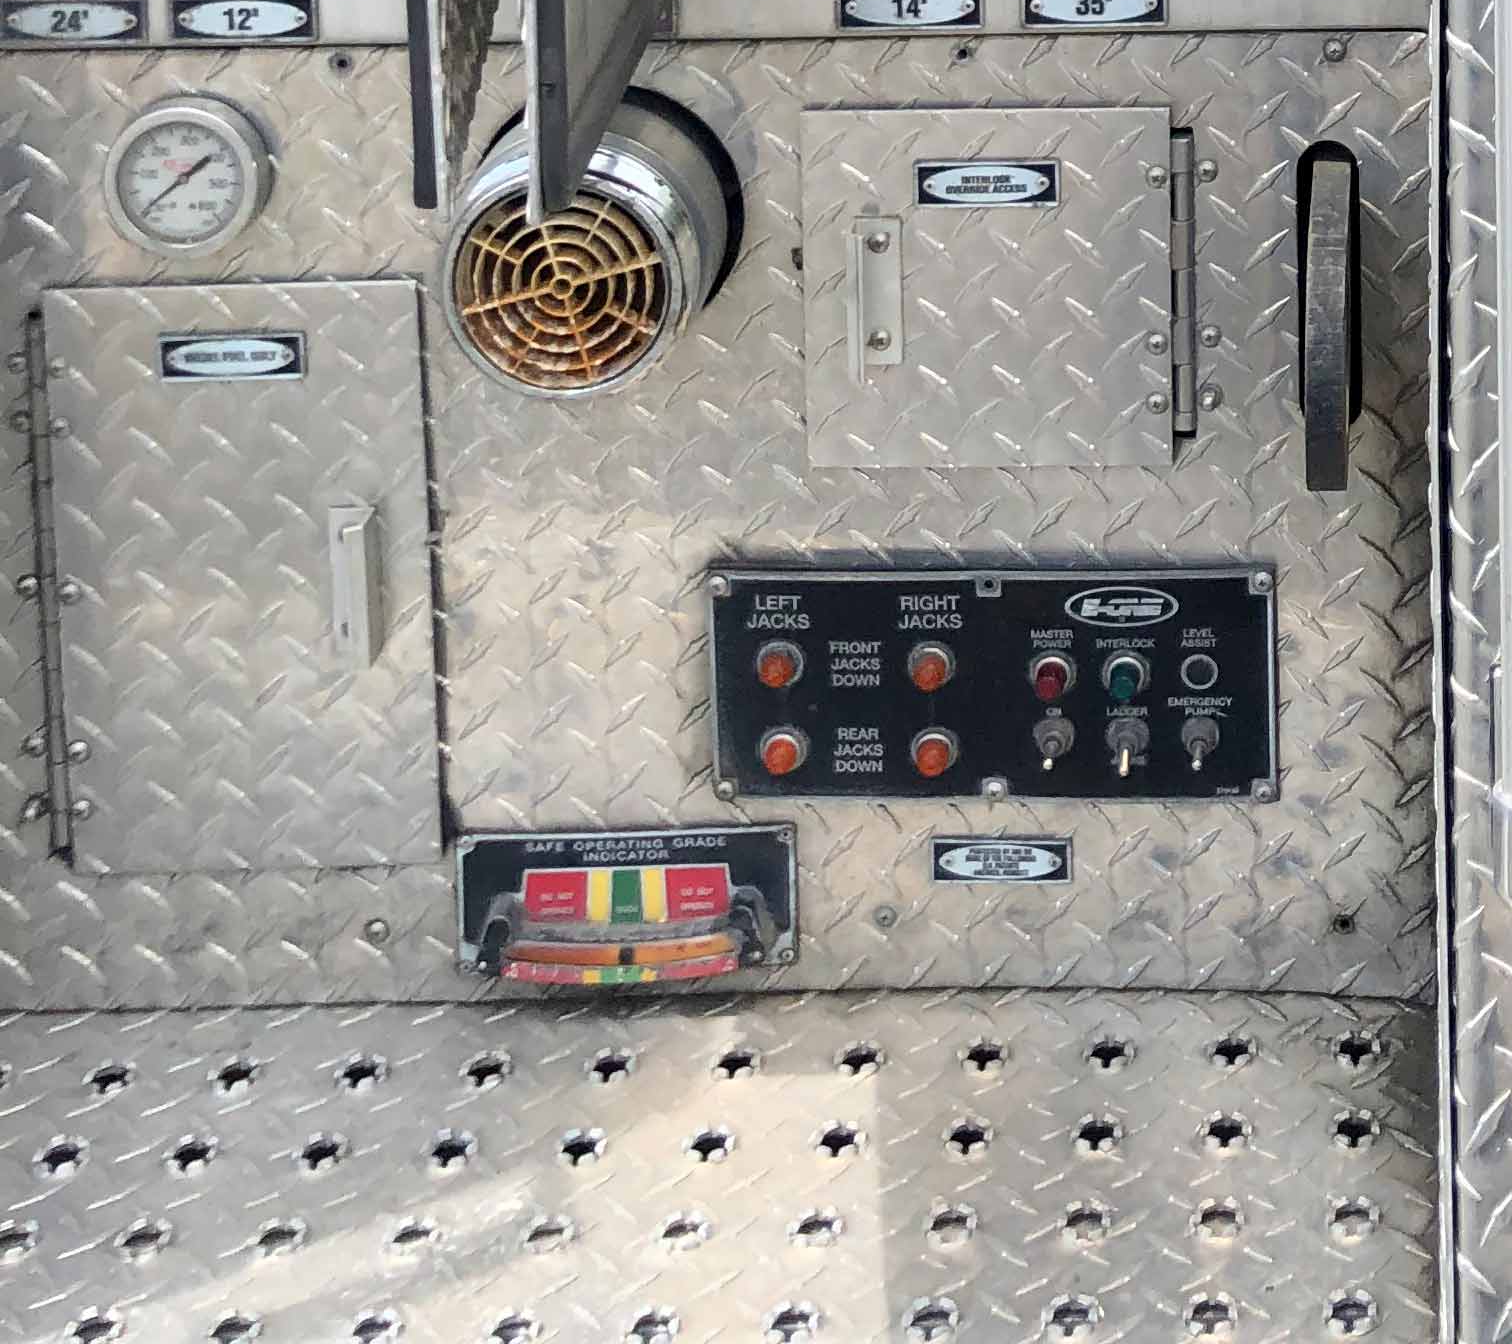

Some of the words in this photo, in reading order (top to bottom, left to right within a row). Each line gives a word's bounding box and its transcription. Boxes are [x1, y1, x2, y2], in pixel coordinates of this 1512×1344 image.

[961, 175, 1011, 184] INTERLOCK
[945, 185, 990, 194] OVERRIDE
[992, 183, 1028, 193] ACCESS
[754, 596, 802, 611] LEFT
[900, 595, 961, 611] RIGHT
[747, 614, 811, 630] JACKS
[898, 614, 963, 630] JACKS
[1030, 629, 1074, 639] MASTER
[1183, 628, 1214, 638] LEVEL
[829, 641, 881, 654] FRONT
[1033, 639, 1072, 649] POWER
[1096, 638, 1155, 649] INTERLOCK
[1180, 638, 1217, 648] ASSIST
[831, 658, 881, 671] JACKS
[832, 674, 881, 687] DOWN
[1167, 697, 1233, 707] EMERGENCY
[1045, 707, 1062, 716] ON
[1106, 706, 1148, 716] LADDER
[1185, 706, 1217, 716] PUMP
[837, 727, 879, 740] REAR
[833, 744, 884, 757] JACKS
[835, 760, 884, 773] DOWN
[524, 841, 564, 853] SAFE
[573, 838, 664, 851] OPERATING
[674, 835, 728, 849] GRADE
[582, 849, 671, 862] INDICATOR
